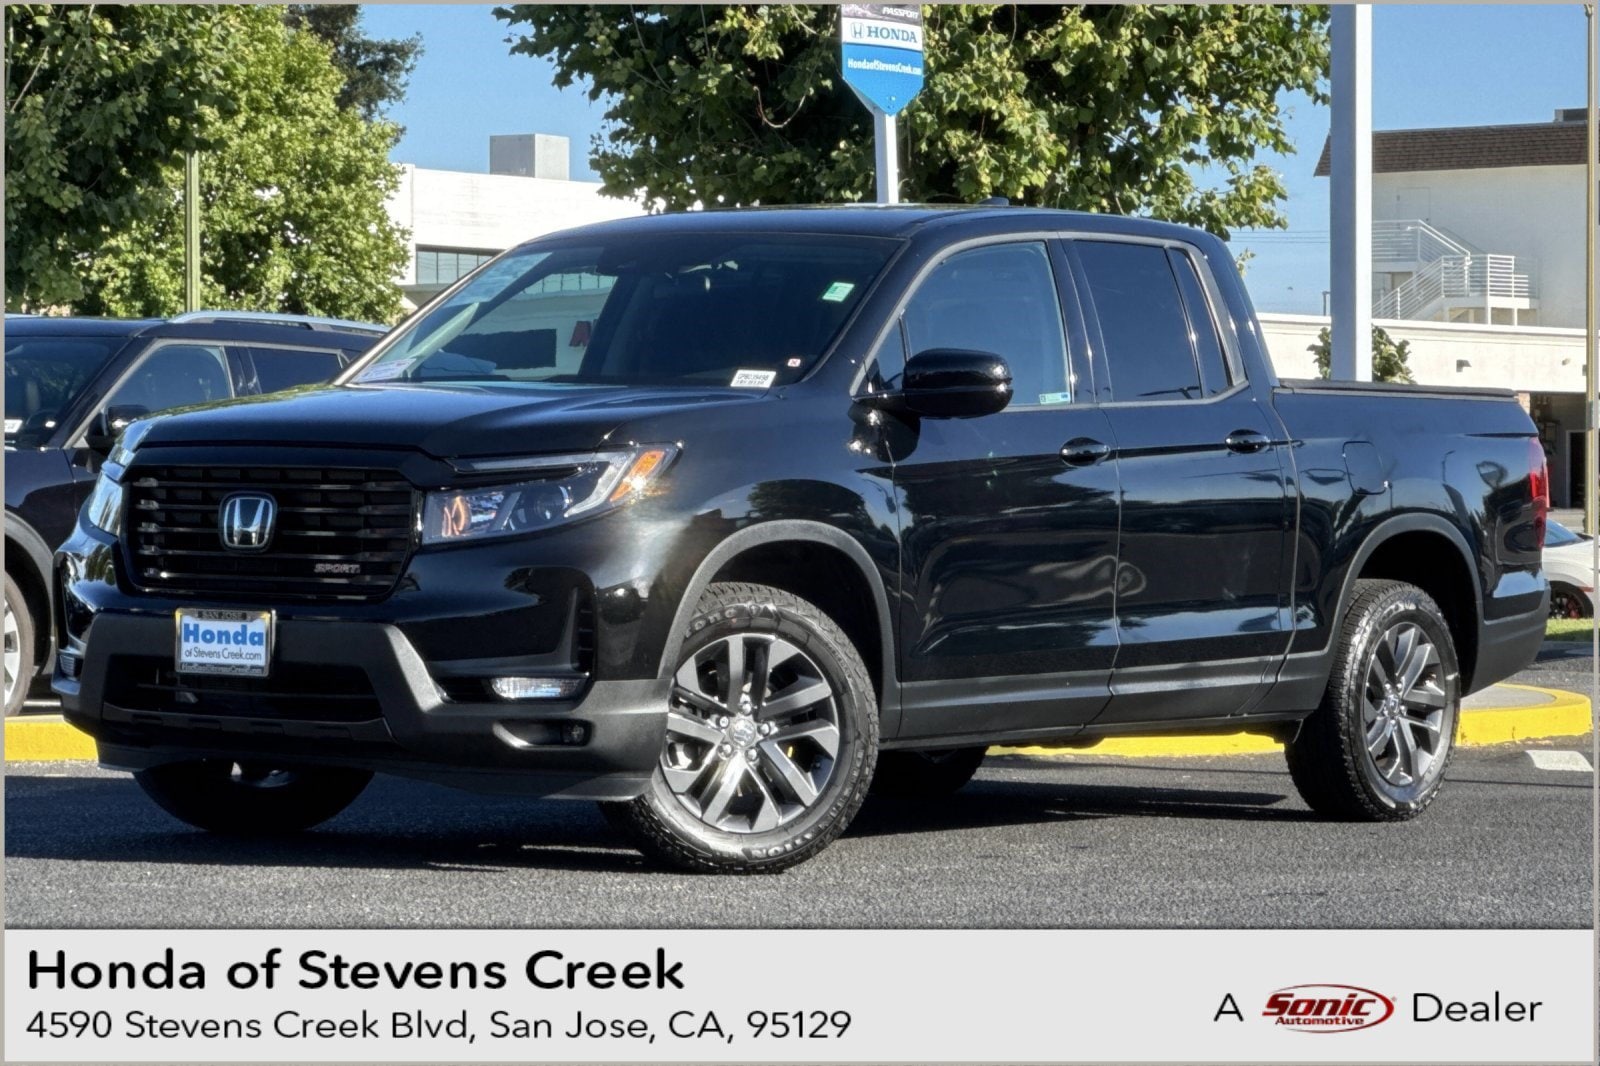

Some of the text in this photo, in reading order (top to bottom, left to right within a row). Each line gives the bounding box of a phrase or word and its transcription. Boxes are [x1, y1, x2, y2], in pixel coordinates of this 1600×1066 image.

[882, 6, 919, 19] PASSPORT
[866, 25, 918, 43] HONDA
[314, 563, 361, 574] SPORT
[183, 623, 264, 646] Honda
[185, 648, 193, 658] of
